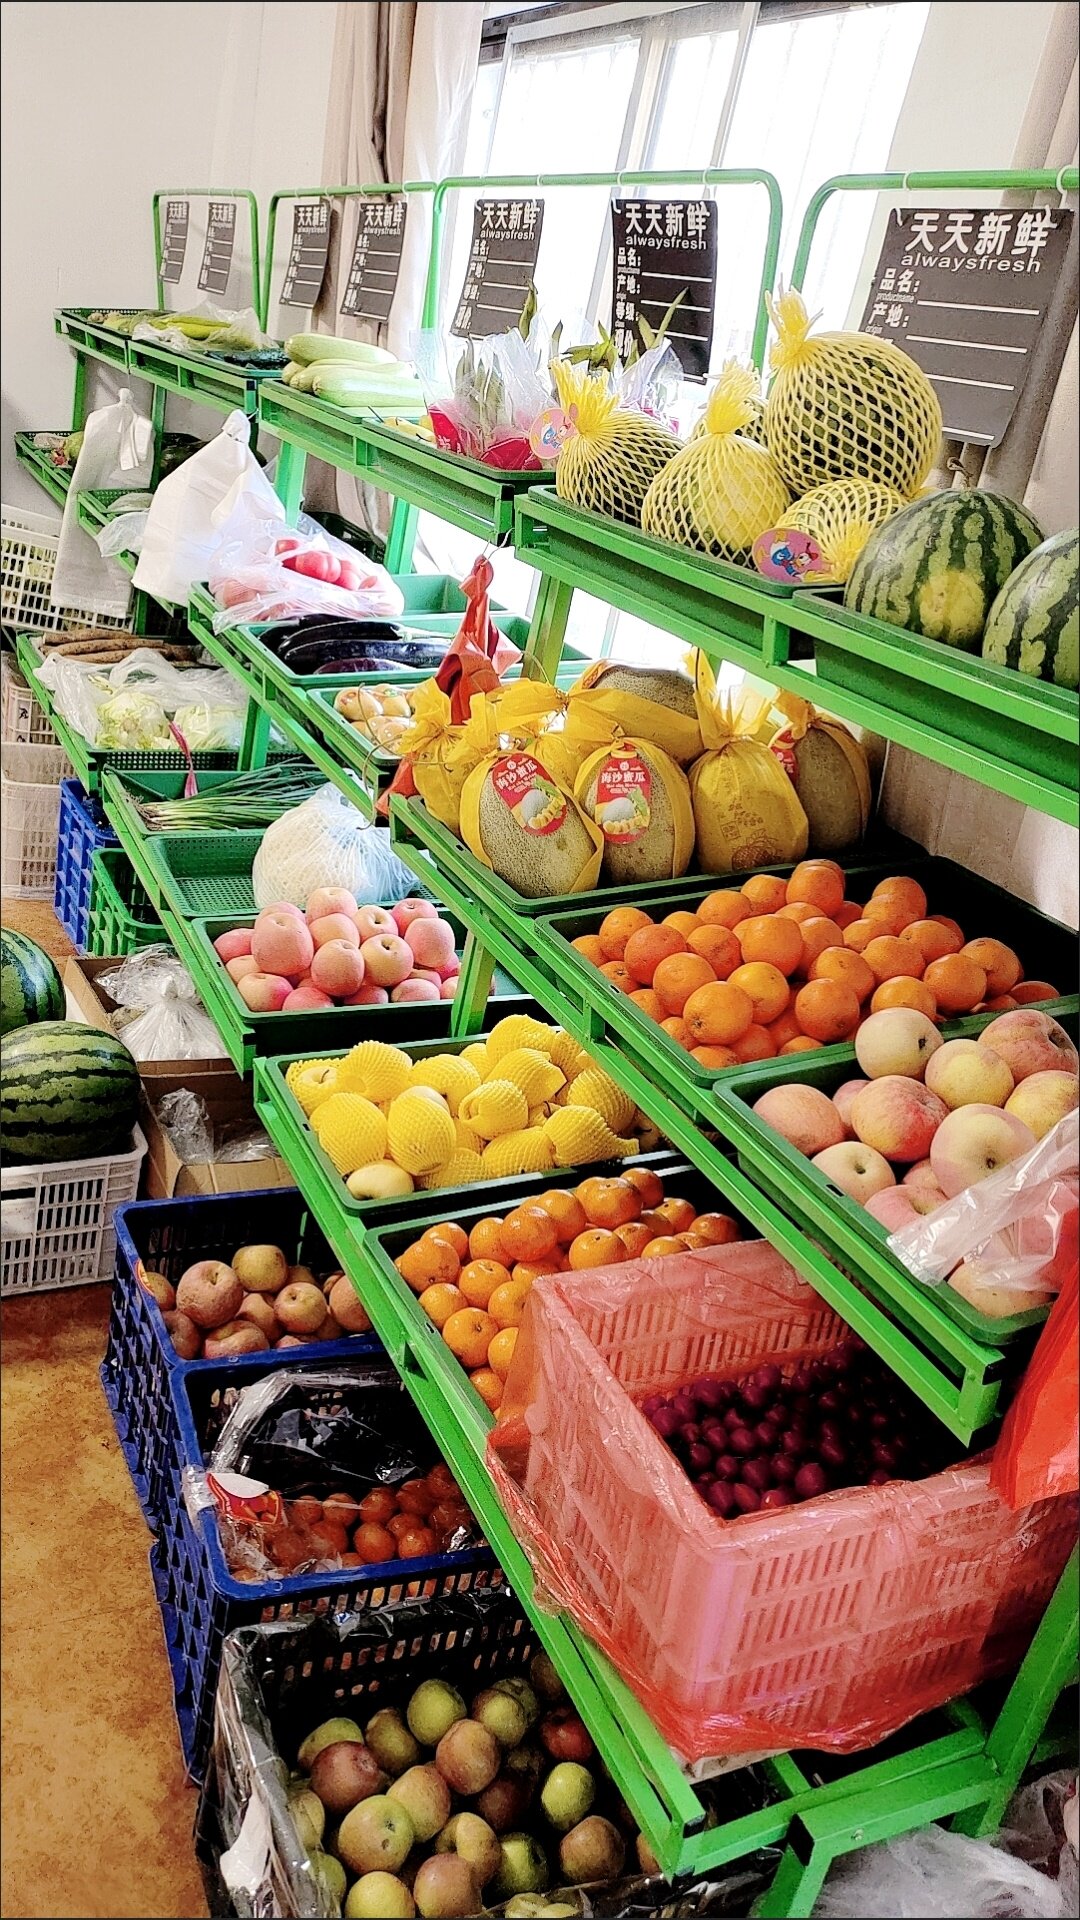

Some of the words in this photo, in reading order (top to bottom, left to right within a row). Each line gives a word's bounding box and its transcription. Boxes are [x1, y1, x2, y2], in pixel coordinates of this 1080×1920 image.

[364, 203, 403, 228] 天天新鲜
[482, 202, 538, 230] 天天新鲜
[625, 202, 709, 238] 天天新鲜
[480, 229, 535, 241] alwaysfresh
[625, 234, 707, 250] alwaysfresh
[905, 211, 1051, 258] 天天新鲜
[901, 252, 1041, 273] alwaysfresh
